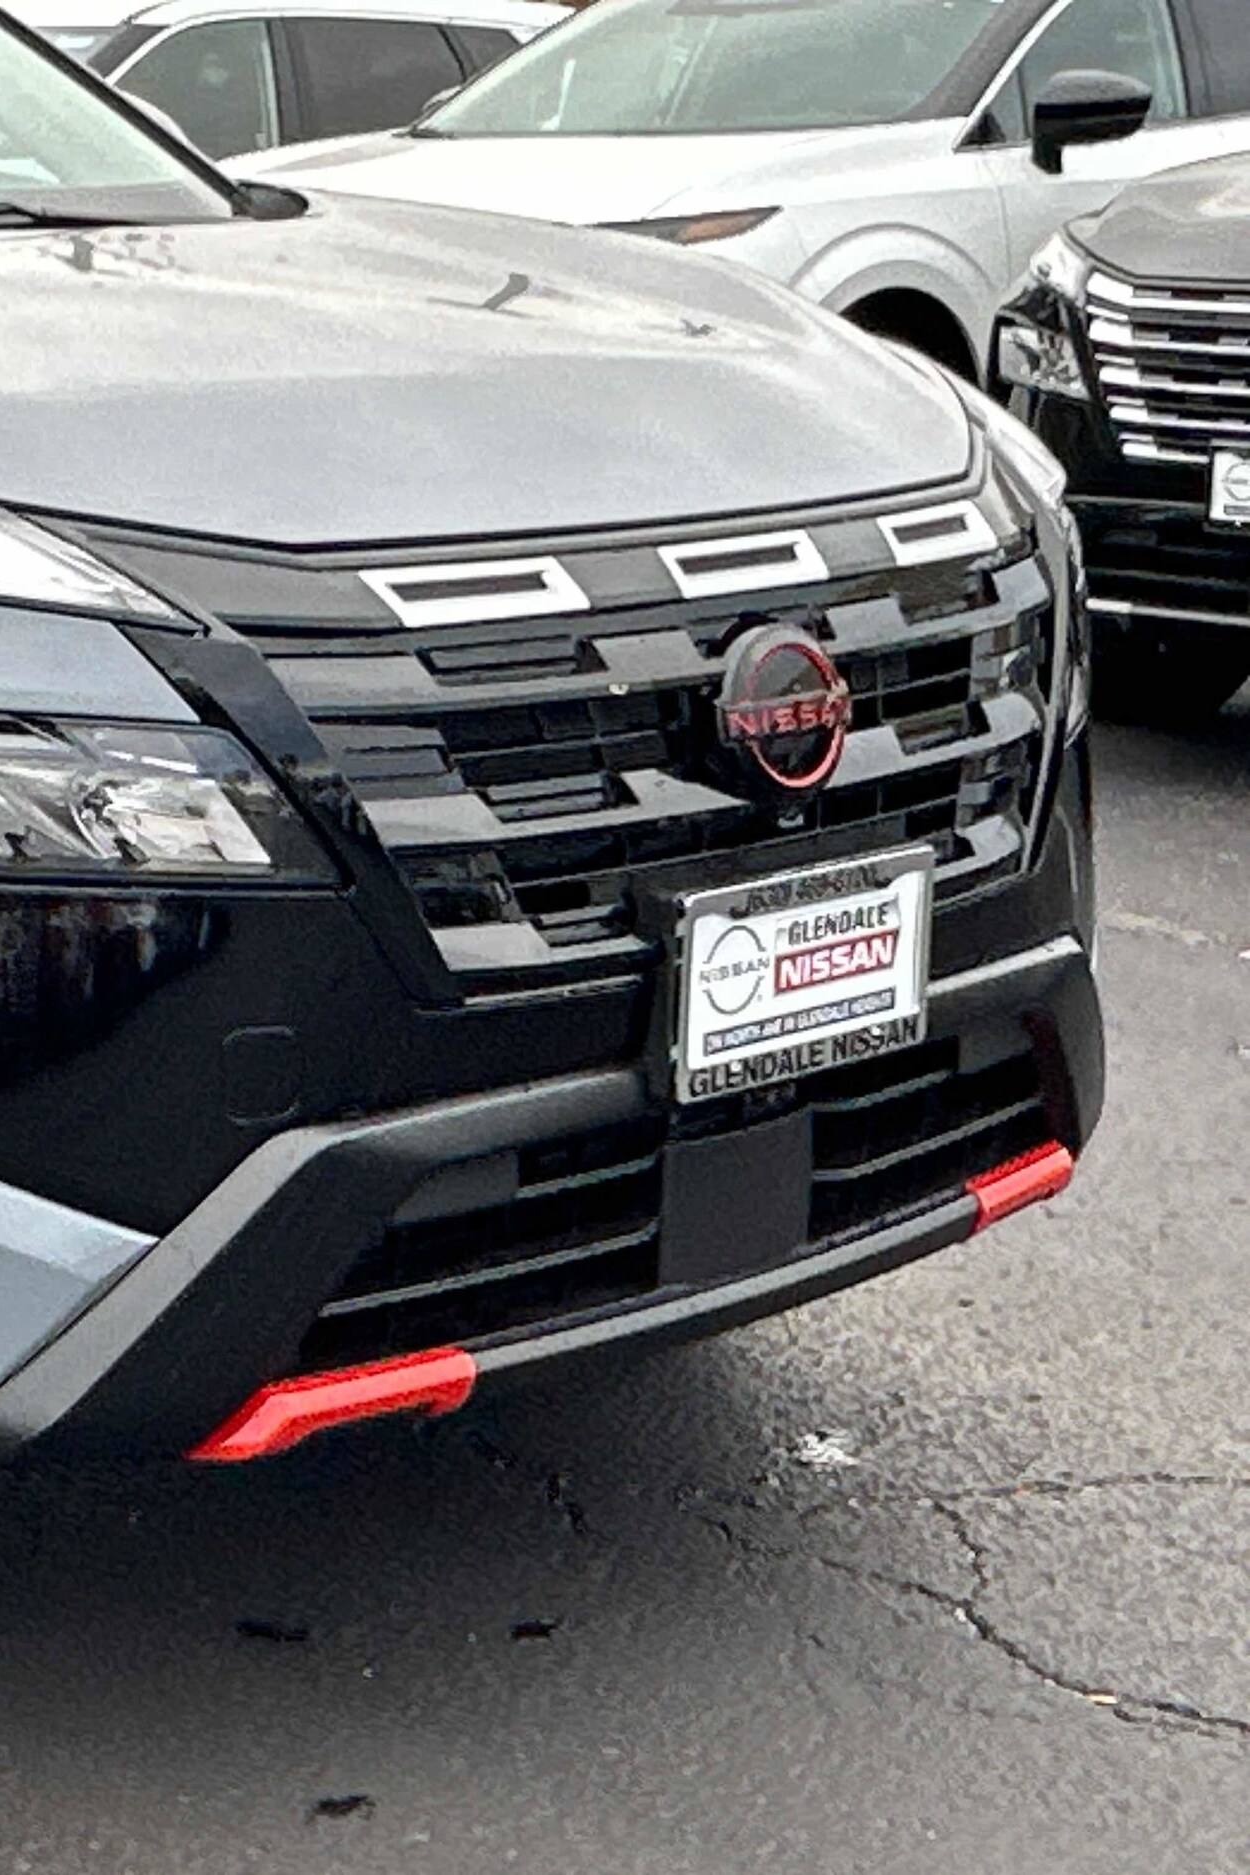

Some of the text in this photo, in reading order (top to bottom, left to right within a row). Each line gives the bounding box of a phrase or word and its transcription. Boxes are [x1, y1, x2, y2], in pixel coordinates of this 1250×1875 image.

[787, 902, 889, 947] GLENDALE
[778, 935, 896, 989] NISSAN
[688, 1040, 826, 1098] GLENDALE
[831, 1014, 918, 1062] NISSAN
